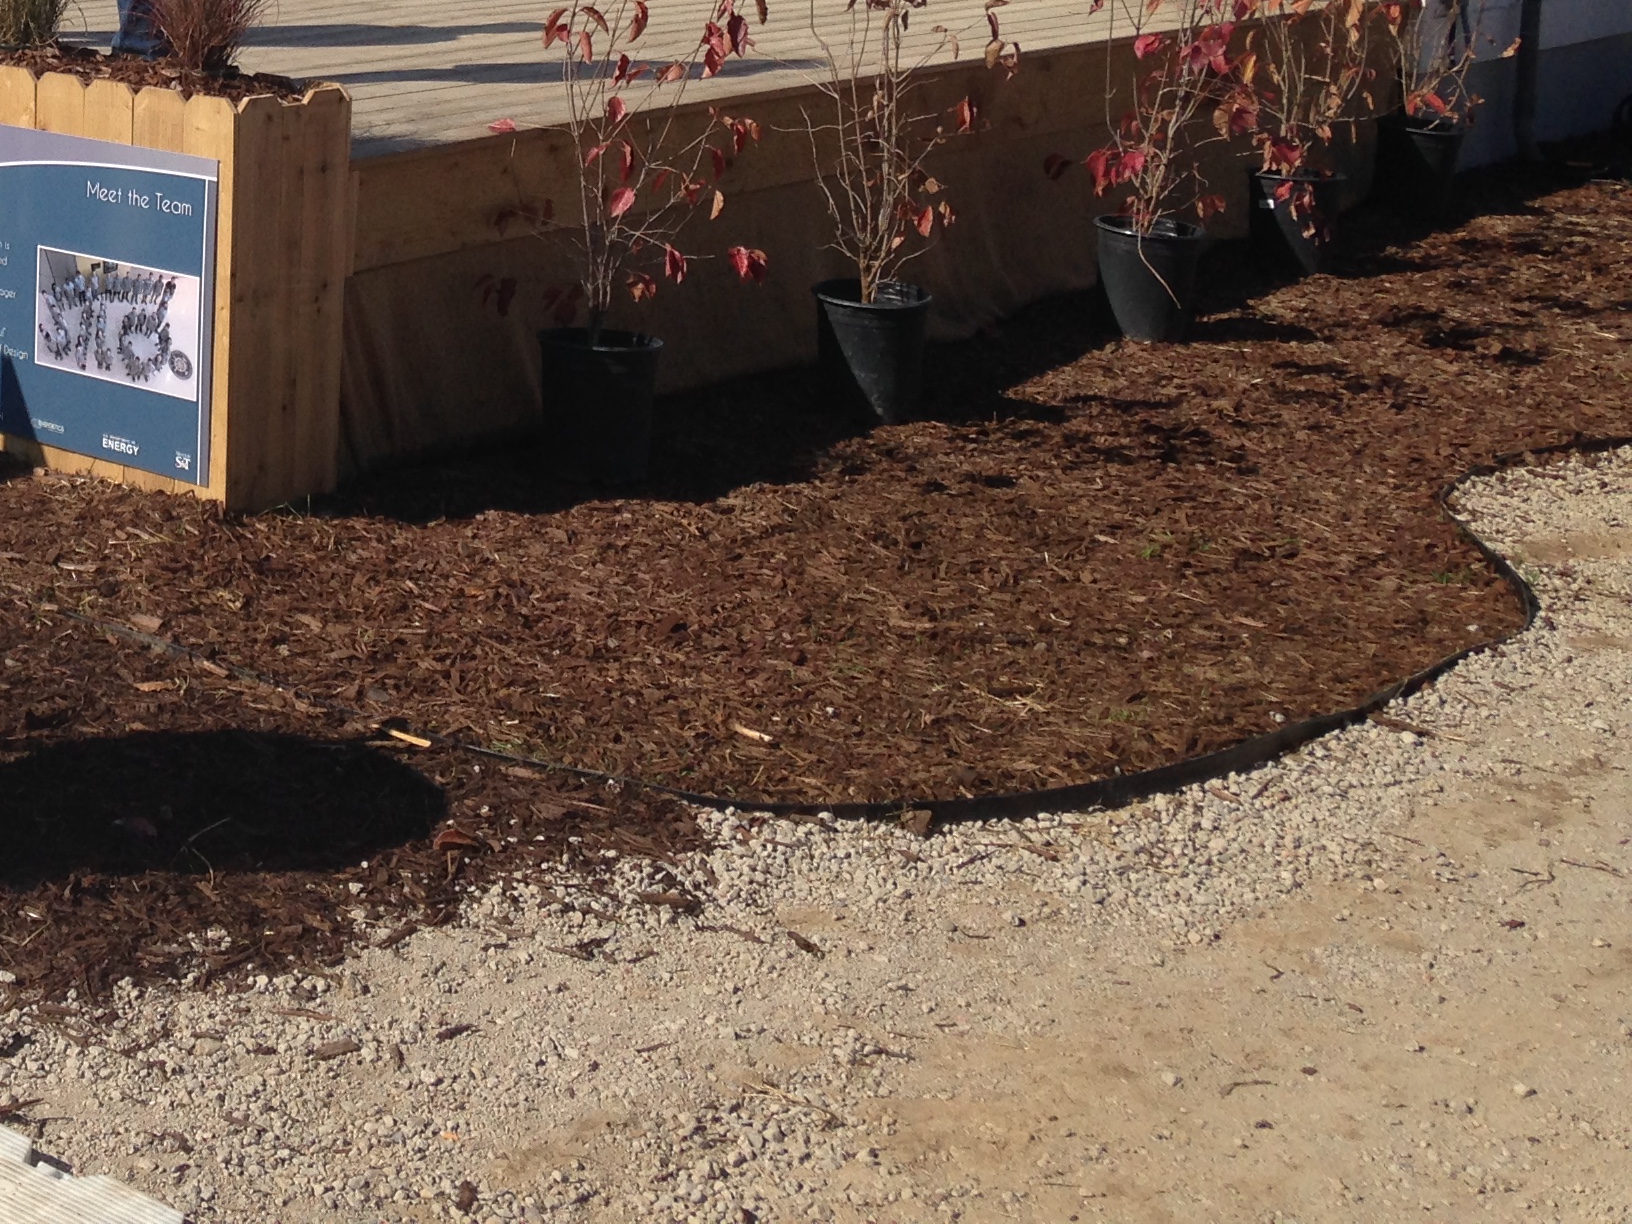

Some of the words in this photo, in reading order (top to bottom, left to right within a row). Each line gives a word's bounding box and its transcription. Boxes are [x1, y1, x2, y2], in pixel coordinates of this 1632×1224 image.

[86, 180, 122, 204] Meet
[127, 188, 150, 209] the
[154, 192, 193, 217] Team
[3, 343, 29, 361] Design
[102, 437, 140, 456] ENERGY
